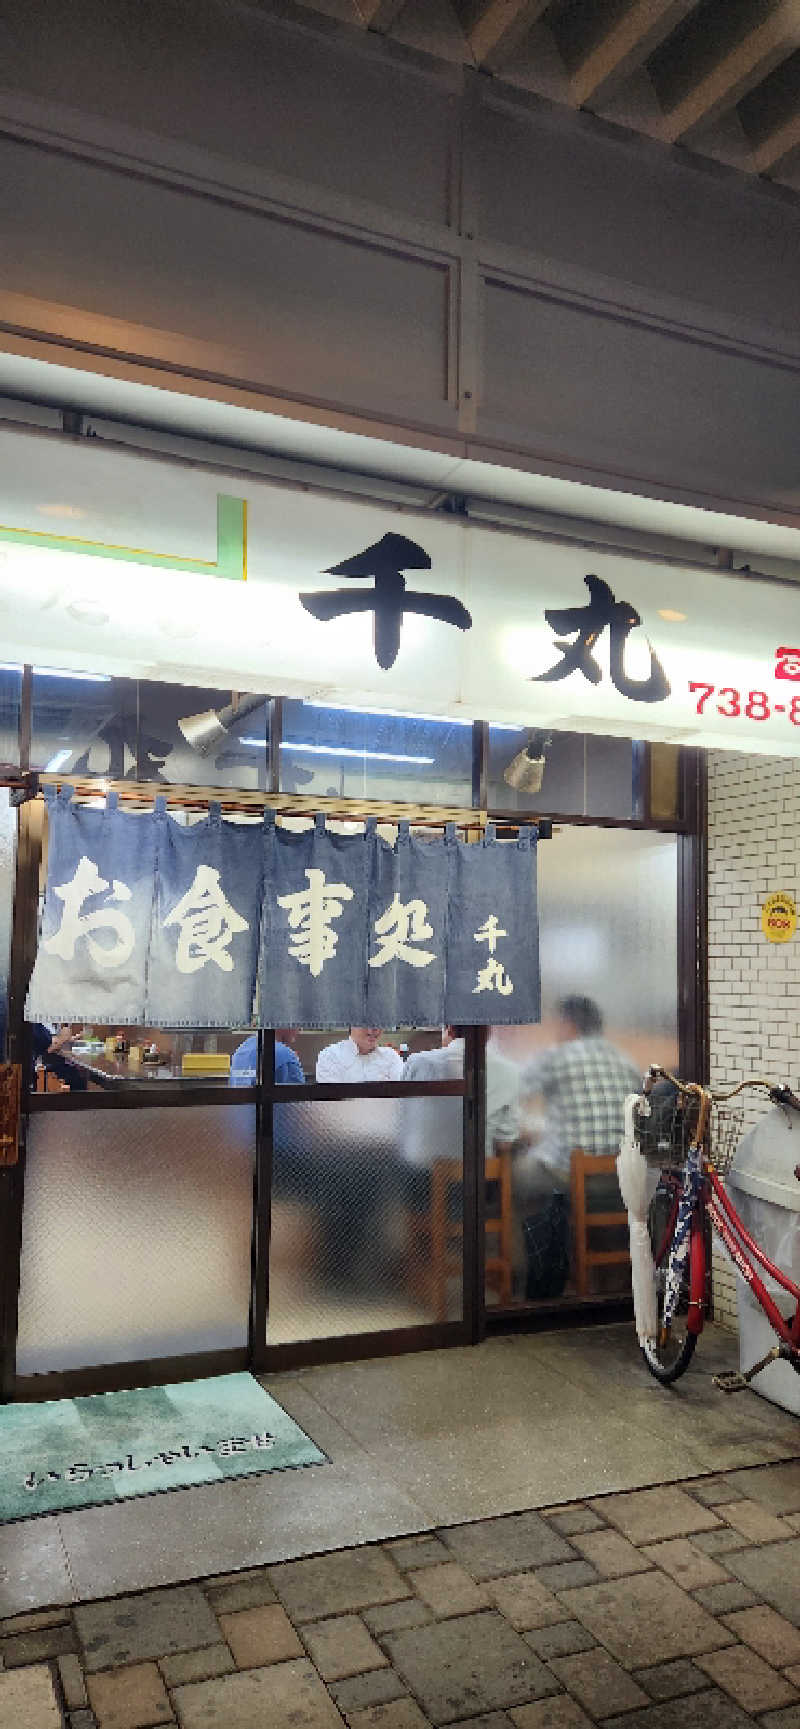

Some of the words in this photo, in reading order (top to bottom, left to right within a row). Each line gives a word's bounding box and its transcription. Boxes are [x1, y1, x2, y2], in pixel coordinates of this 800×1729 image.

[299, 531, 671, 702] 千丸
[44, 856, 437, 978] お食事処
[473, 914, 514, 996] 千丸
